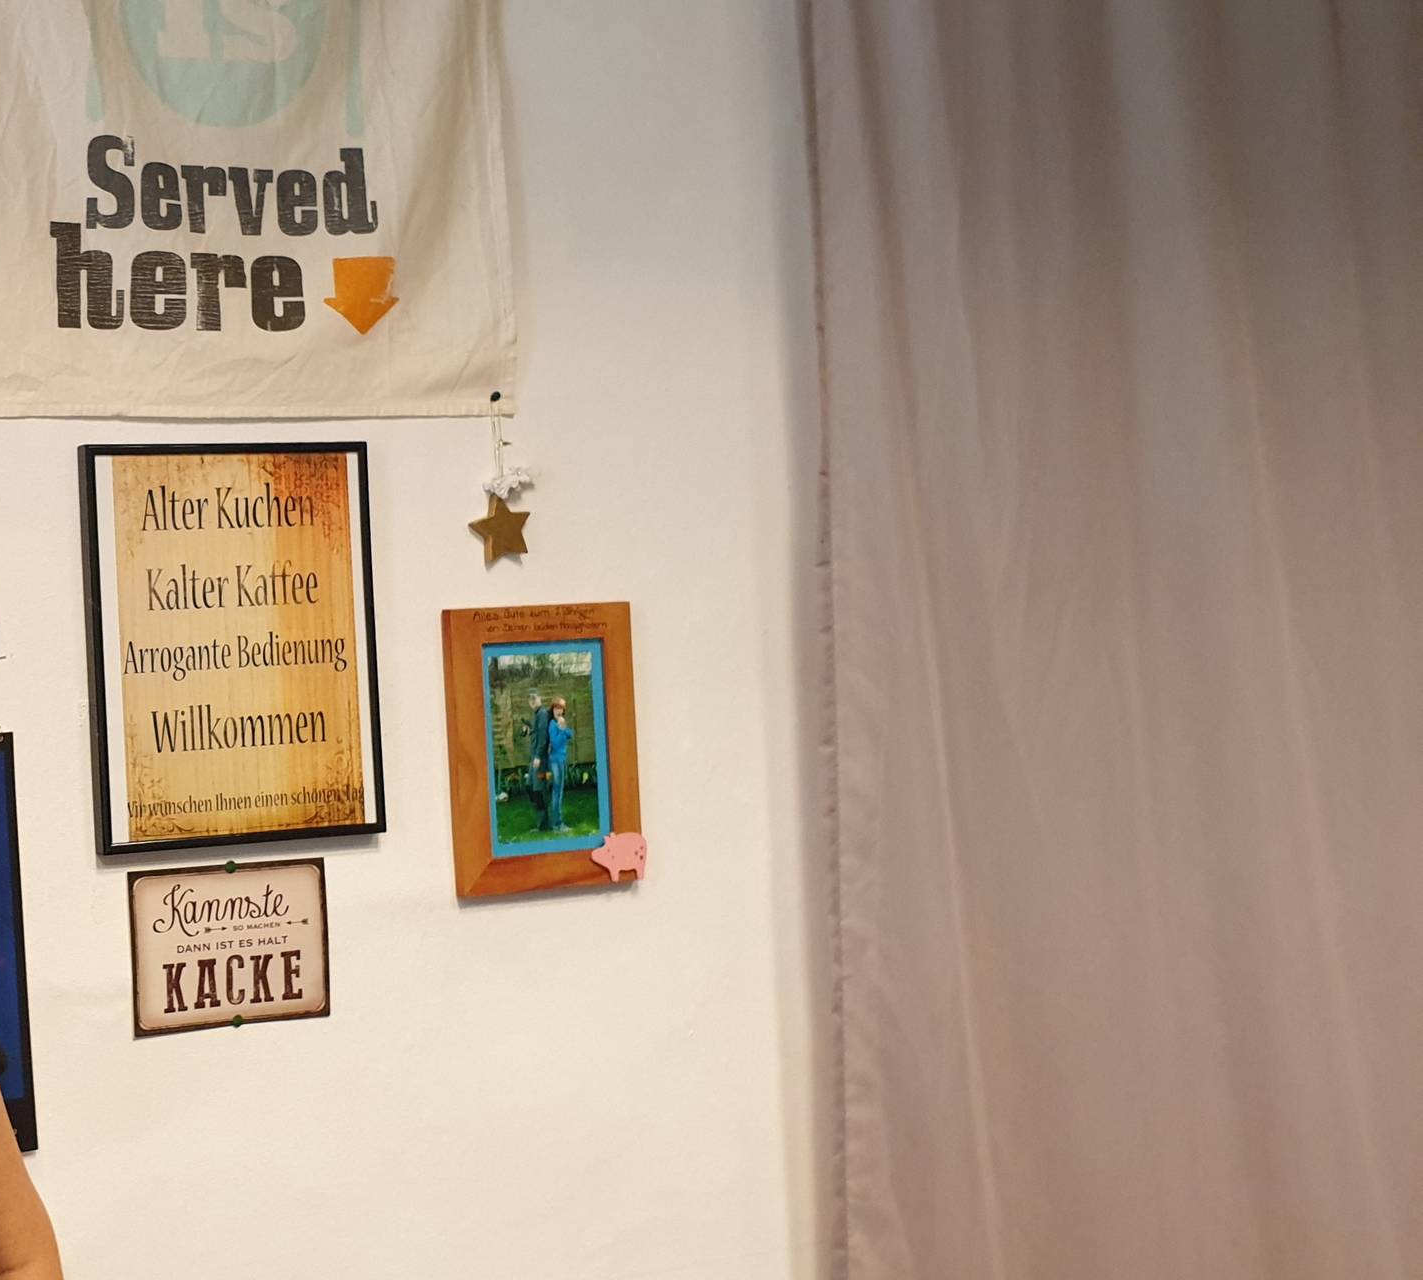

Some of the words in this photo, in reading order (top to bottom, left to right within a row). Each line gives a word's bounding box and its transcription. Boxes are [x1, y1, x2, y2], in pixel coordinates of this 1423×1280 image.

[86, 134, 378, 237] Served
[49, 220, 307, 333] here
[141, 485, 209, 532] Alter
[215, 482, 316, 531] Kuchen
[145, 563, 230, 612] Kalter
[235, 558, 320, 609] Kaffee
[123, 636, 232, 682] Arrogante
[236, 629, 348, 673] Bedienung
[150, 703, 327, 754] Willkommen
[147, 796, 213, 818] wünschen
[215, 792, 252, 812] Ihnen
[254, 790, 288, 808] einen
[291, 786, 341, 806] schönen
[152, 883, 290, 937] Kannste
[232, 923, 245, 931] SO
[246, 921, 281, 930] MACHEN
[176, 942, 211, 954] DANN
[215, 940, 233, 951] IST
[238, 938, 254, 949] ES
[257, 935, 289, 947] HALT
[162, 949, 304, 1014] KACKE
